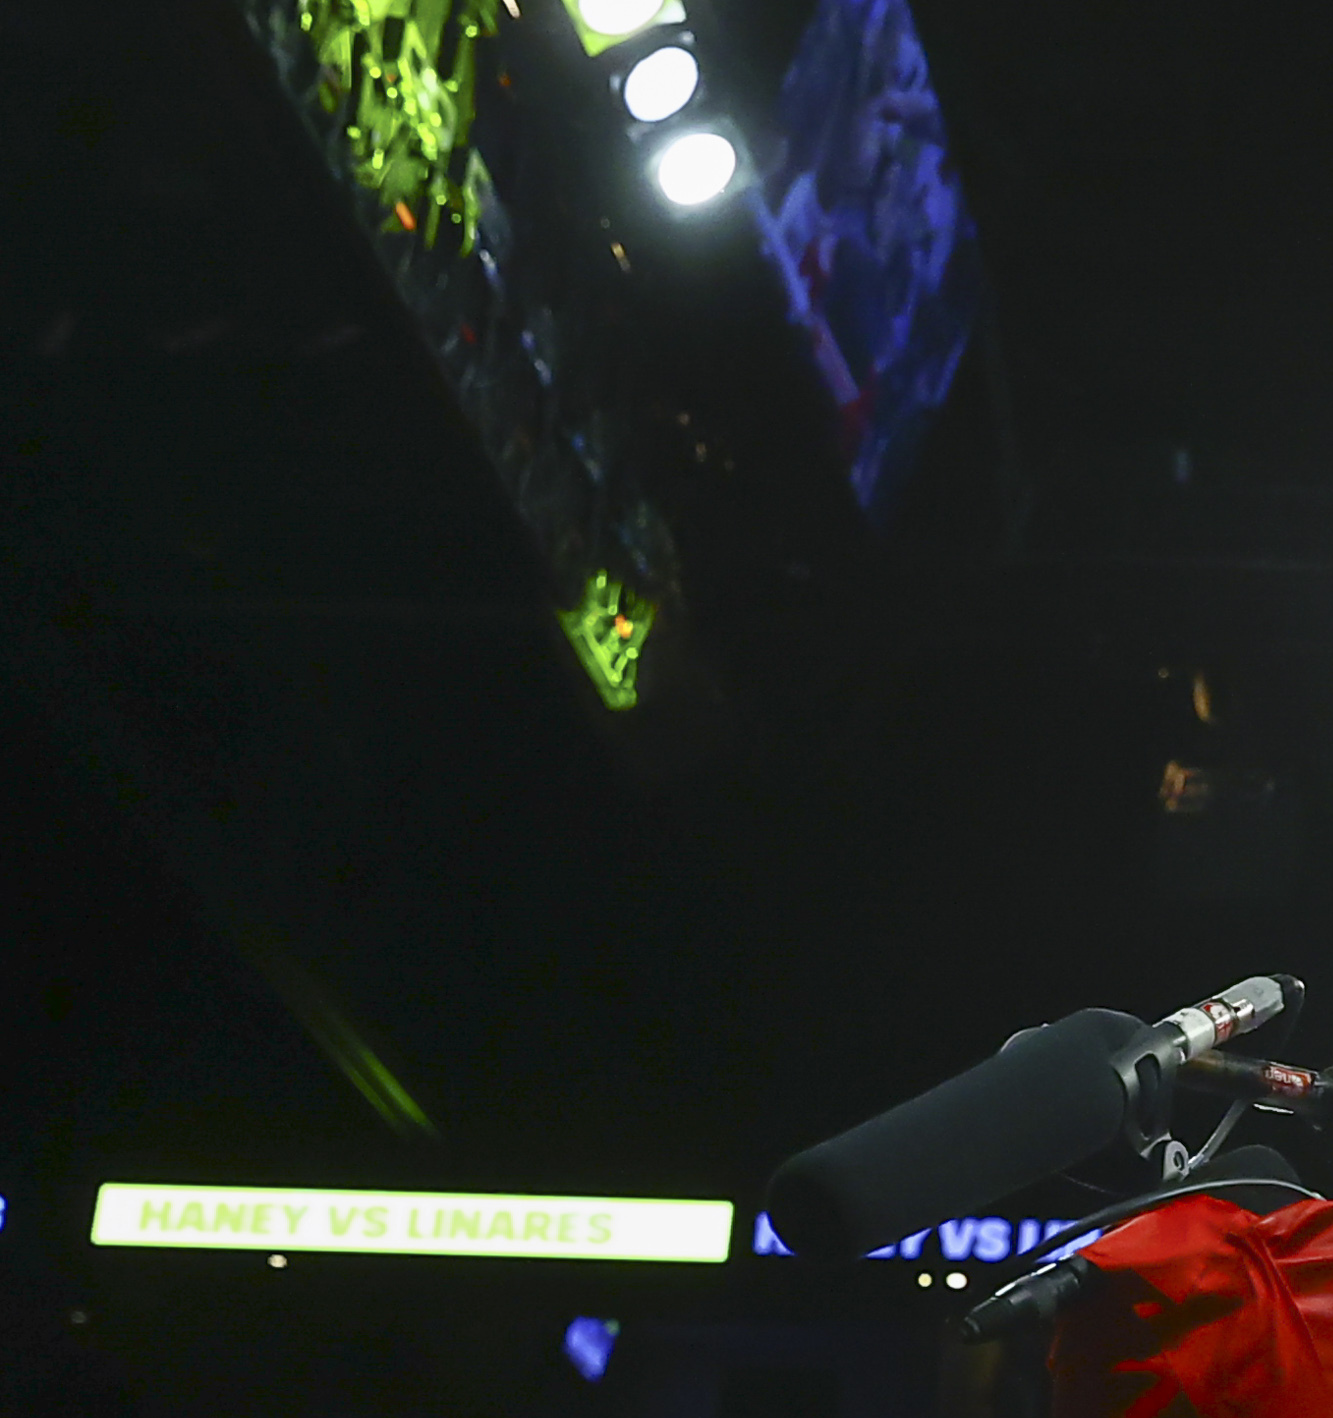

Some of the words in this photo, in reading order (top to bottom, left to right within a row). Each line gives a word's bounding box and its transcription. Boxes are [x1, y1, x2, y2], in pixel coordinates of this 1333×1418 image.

[138, 1199, 310, 1236] HANEY
[328, 1206, 389, 1238] VS
[407, 1208, 614, 1245] LINARES
[937, 1215, 1013, 1262] VS
